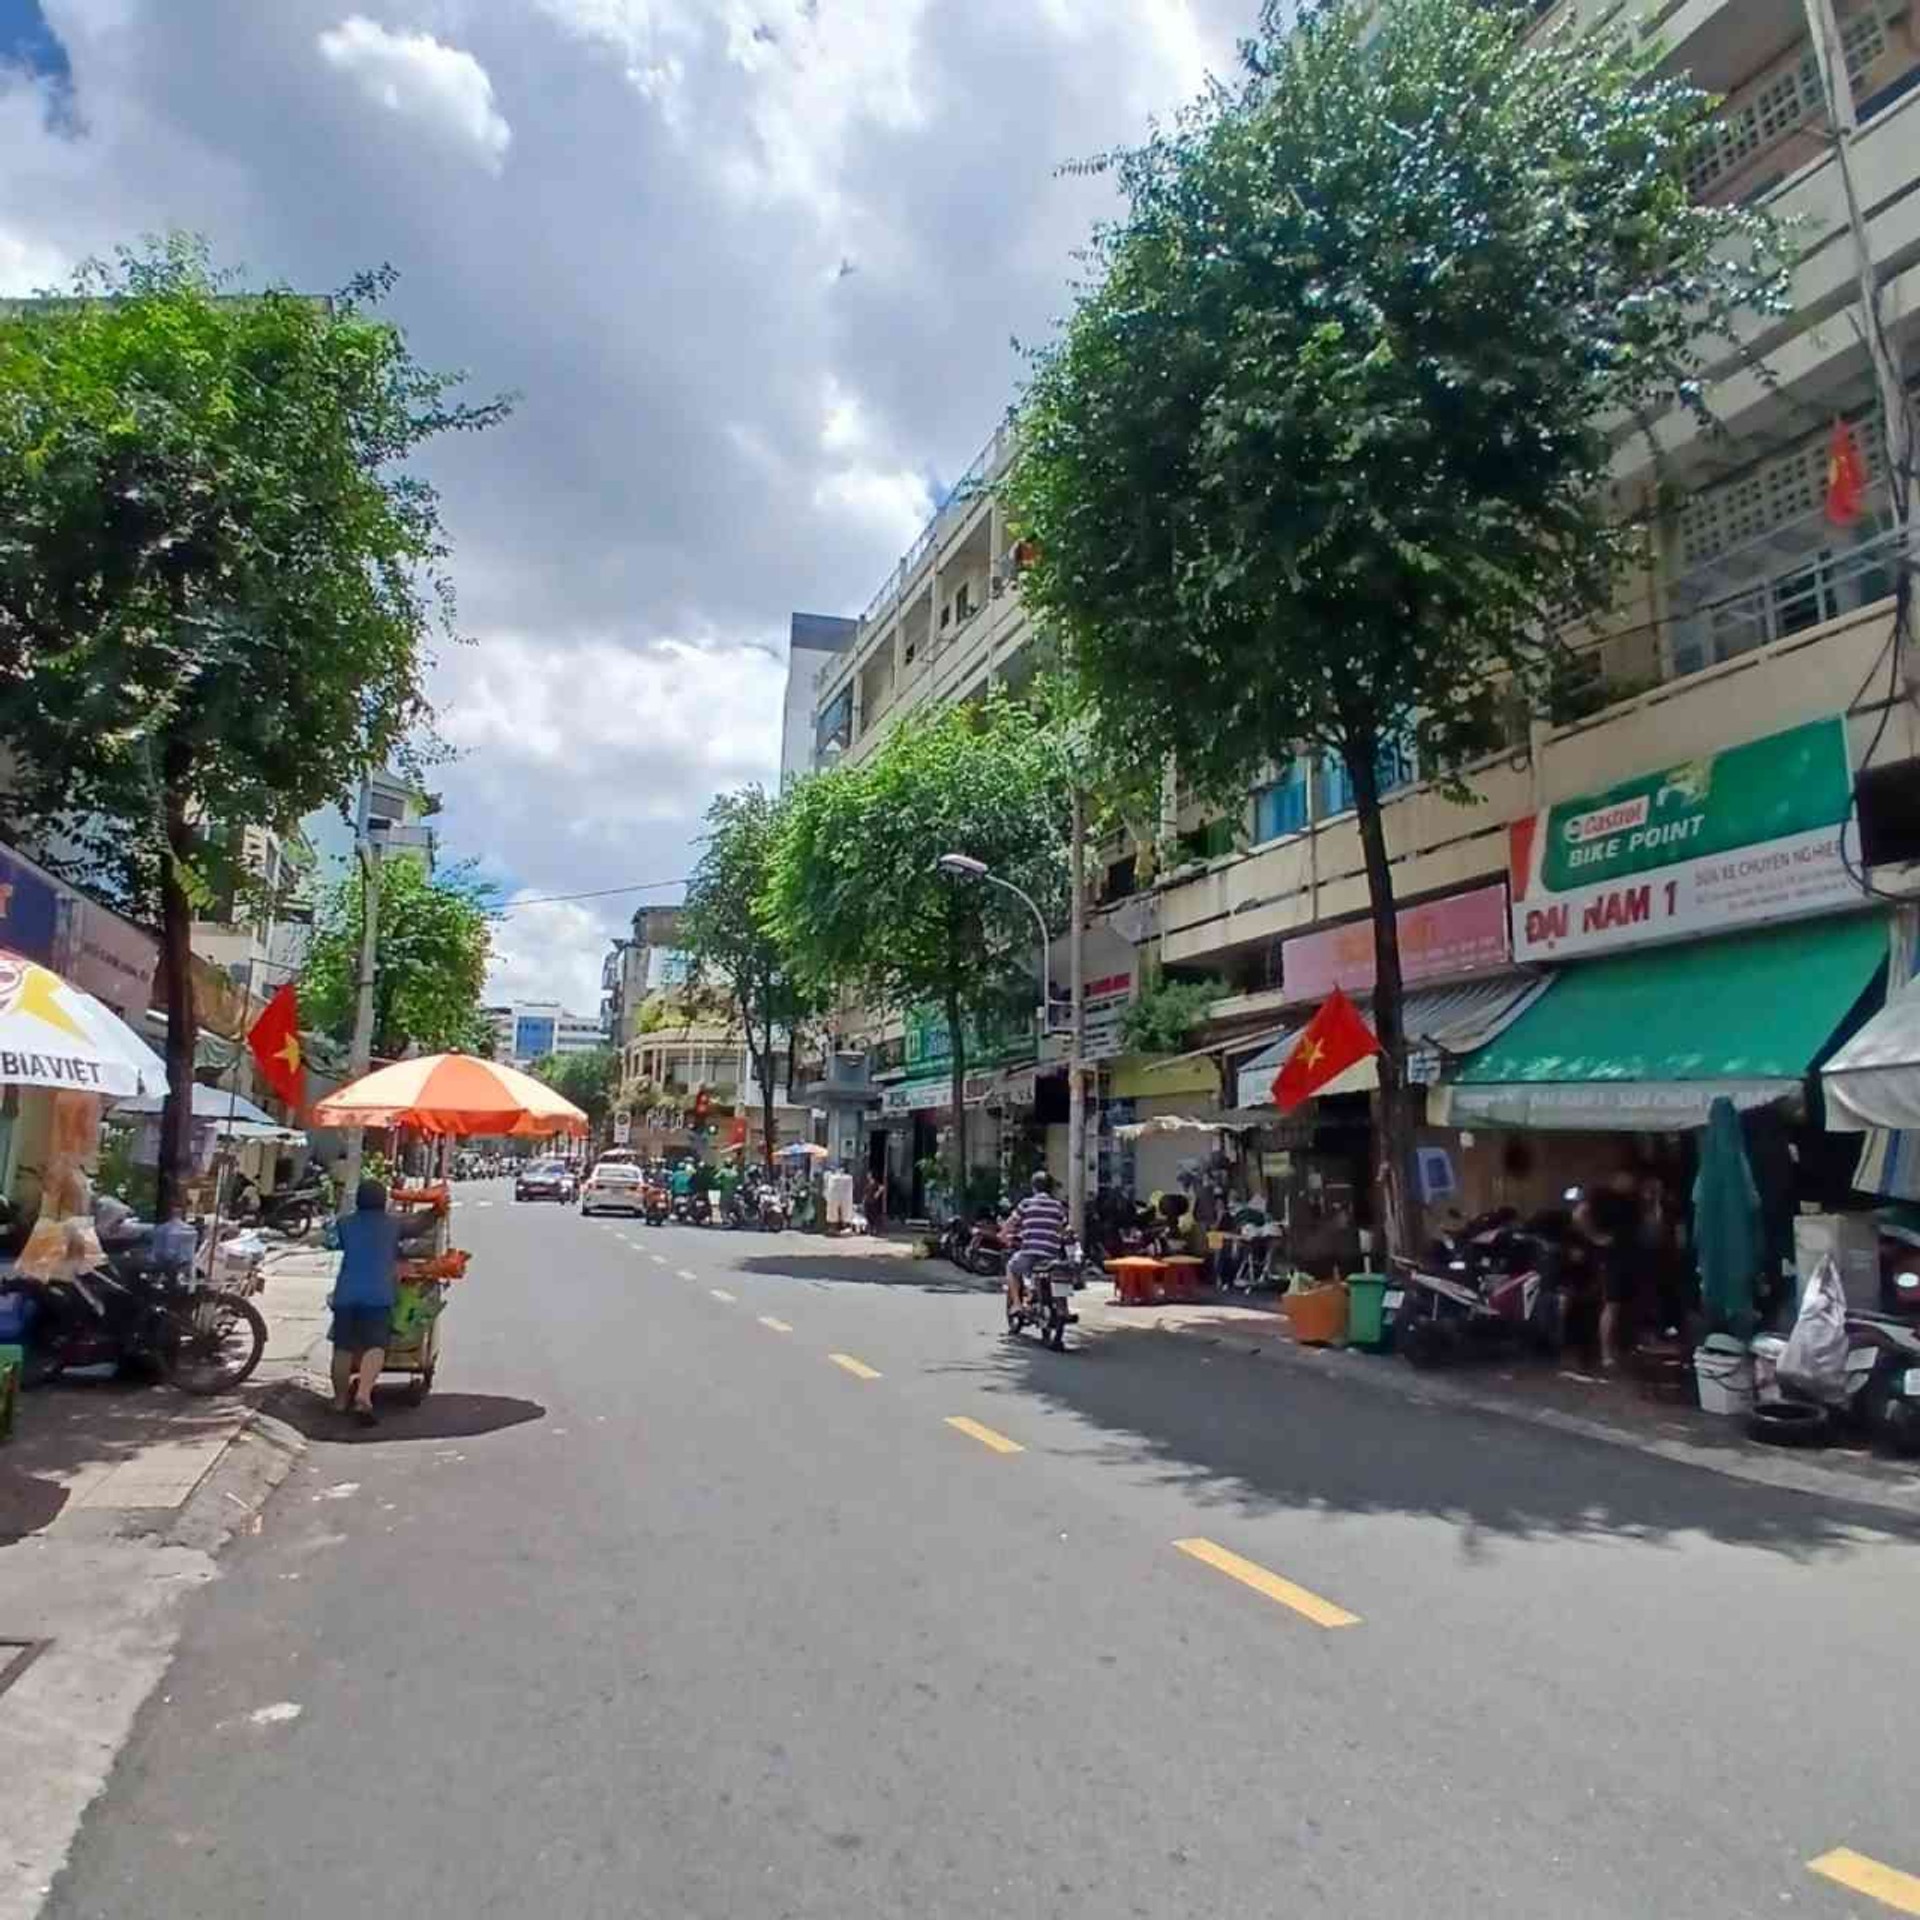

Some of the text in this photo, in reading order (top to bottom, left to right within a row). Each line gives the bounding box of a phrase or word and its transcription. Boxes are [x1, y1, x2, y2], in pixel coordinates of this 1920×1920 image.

[1568, 814, 1705, 868] BIKE POINT
[1584, 802, 1643, 834] Castrol
[1525, 903, 1570, 949] ĐẠI
[1582, 885, 1652, 934] NAM
[1663, 879, 1679, 917] 1
